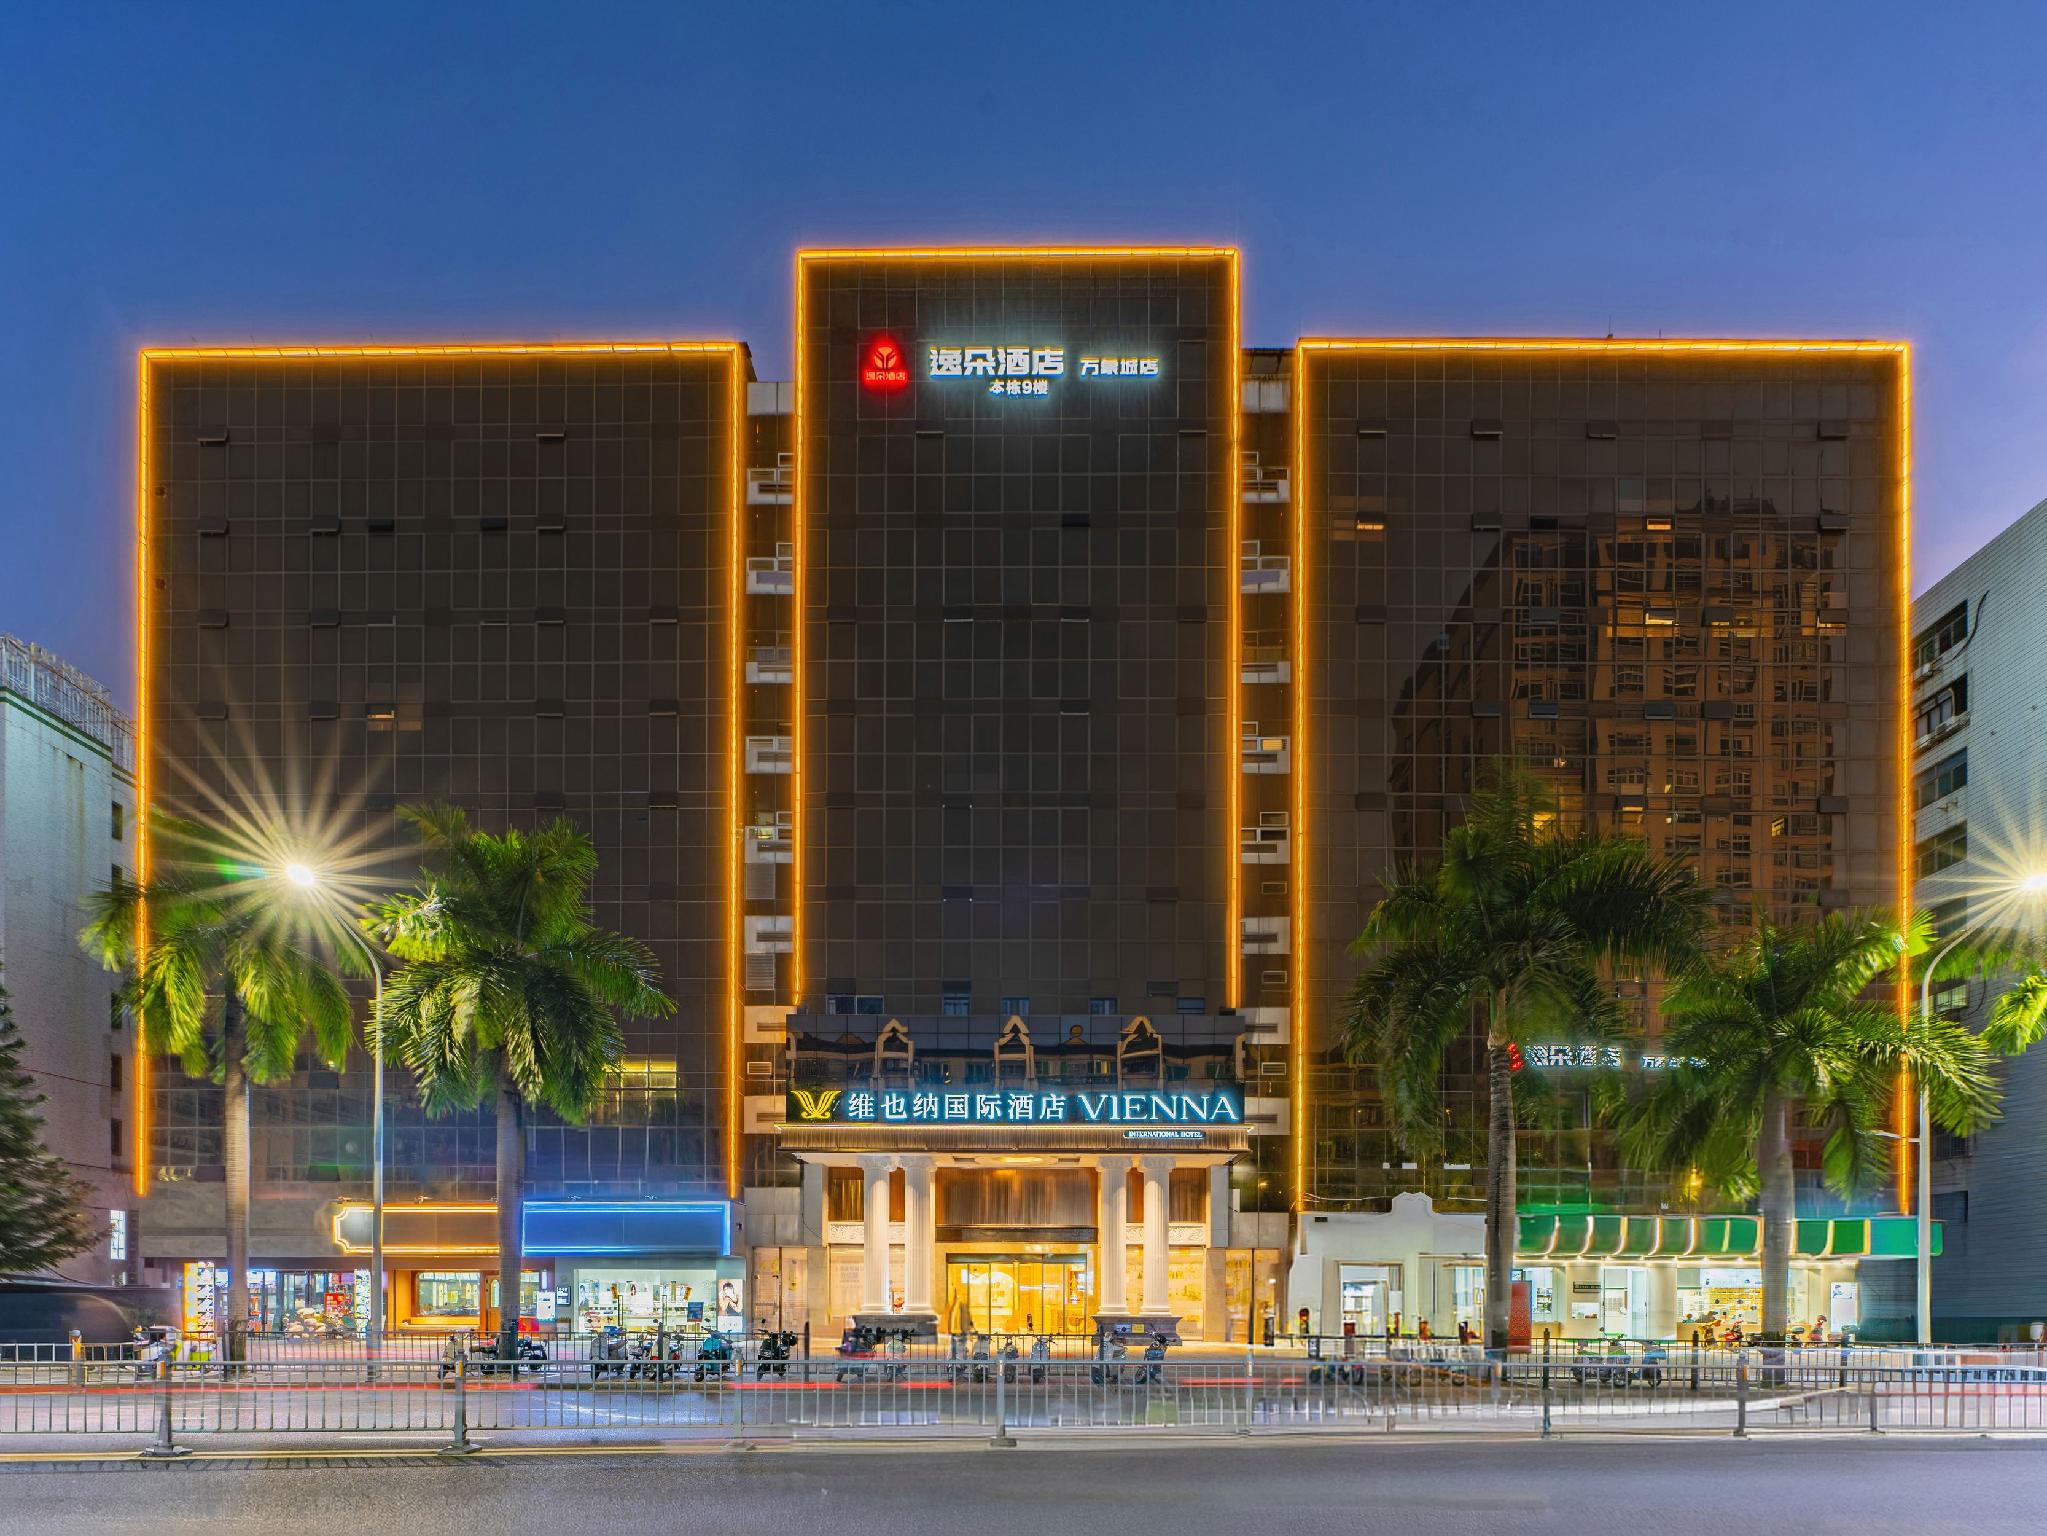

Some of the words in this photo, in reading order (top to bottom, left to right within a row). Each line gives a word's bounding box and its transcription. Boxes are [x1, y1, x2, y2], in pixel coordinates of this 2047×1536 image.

[848, 1092, 1067, 1121] 维也纳国际酒店
[1077, 1095, 1239, 1121] VIENNA
[1128, 1130, 1180, 1138] INTERNATIONAL
